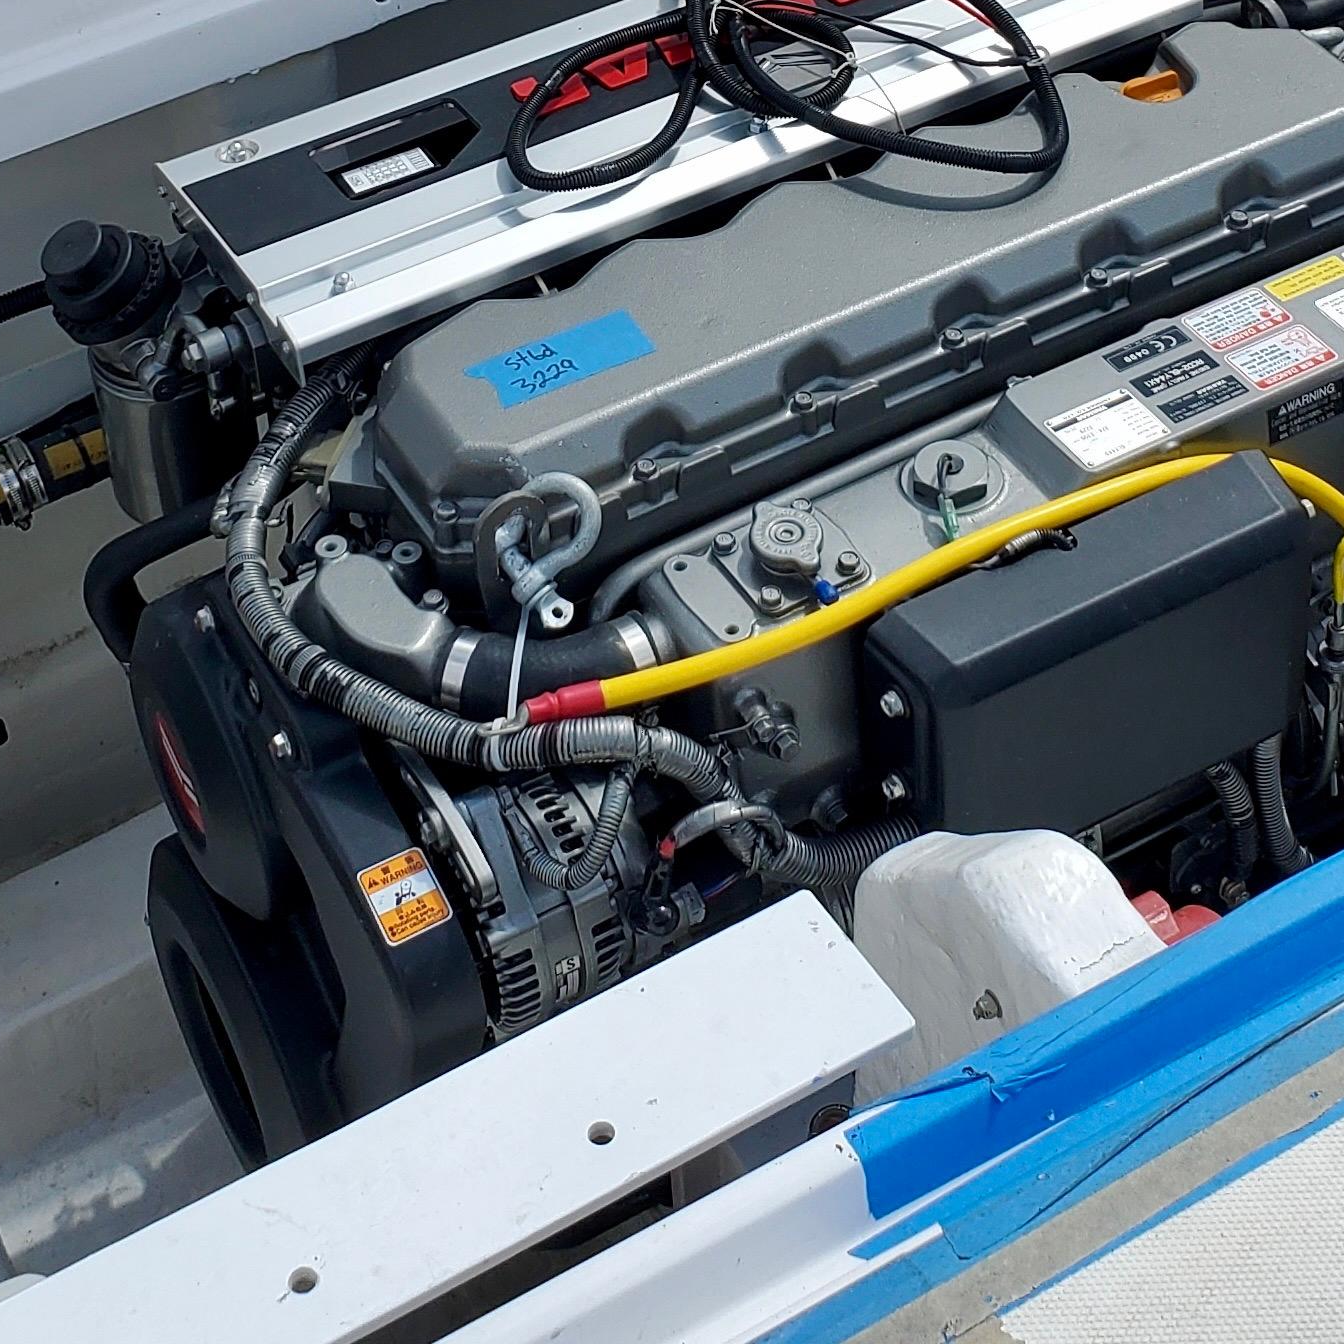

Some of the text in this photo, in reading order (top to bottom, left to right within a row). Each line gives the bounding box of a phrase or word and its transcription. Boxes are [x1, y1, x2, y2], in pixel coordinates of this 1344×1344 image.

[1148, 333, 1177, 352] CE
[1215, 326, 1255, 348] DANGER
[509, 356, 578, 394] 3229
[1263, 366, 1298, 385] DANGER
[1286, 382, 1335, 411] WARNING
[380, 860, 423, 885] WARNING
